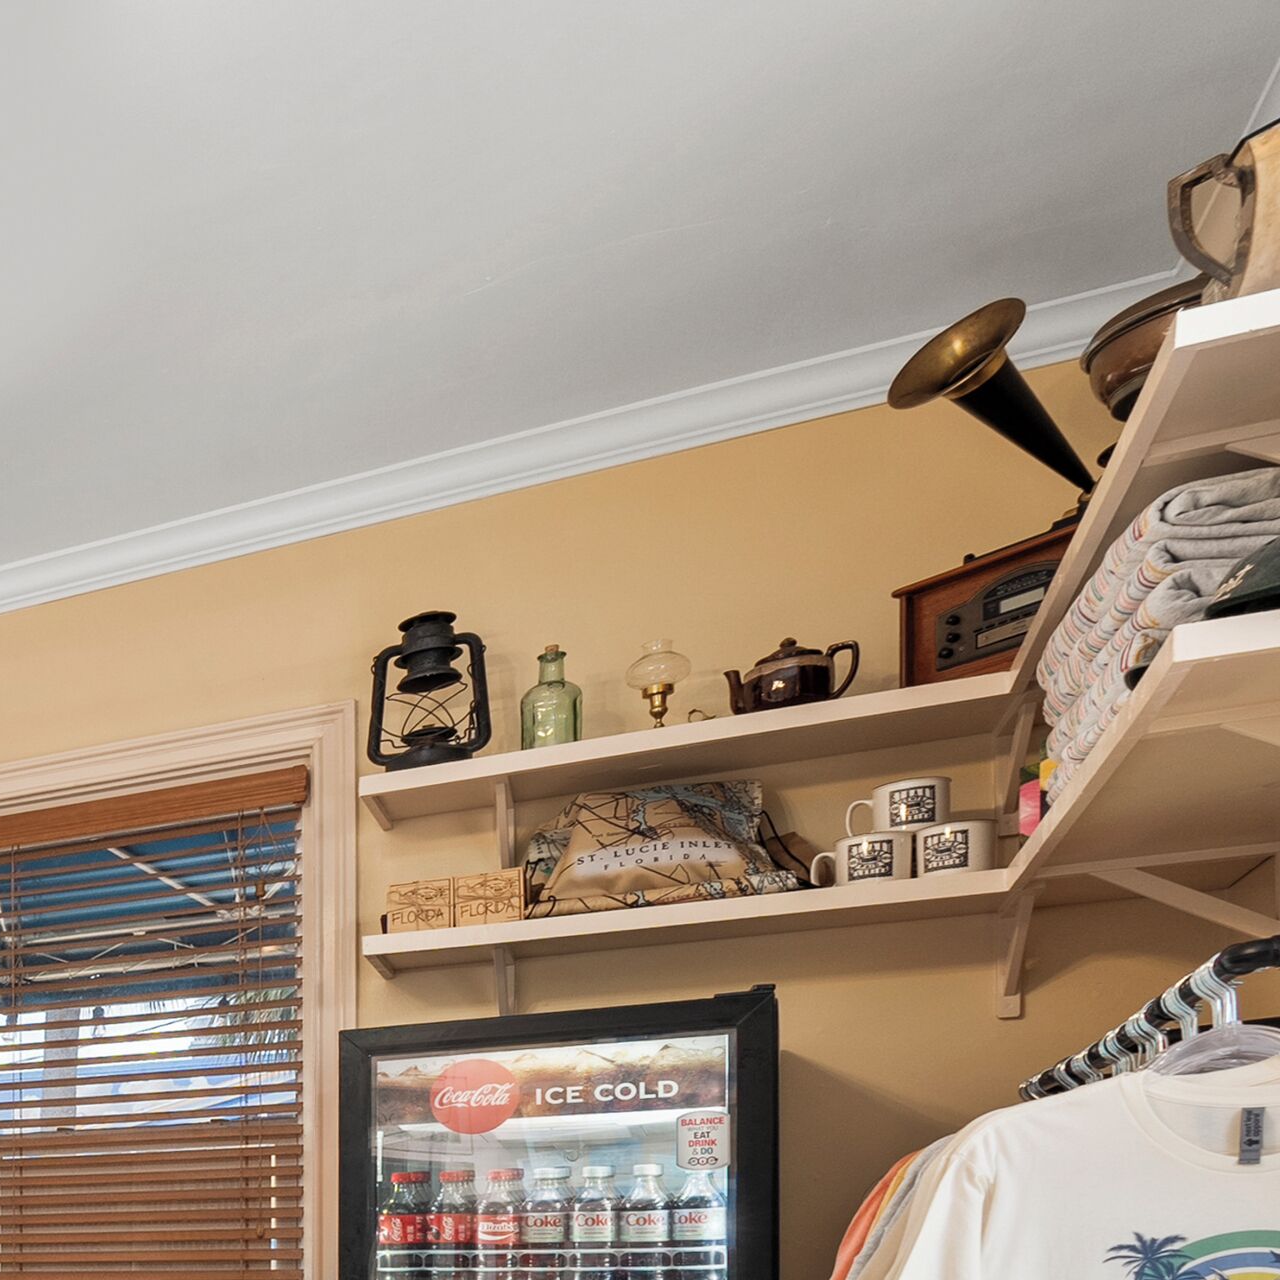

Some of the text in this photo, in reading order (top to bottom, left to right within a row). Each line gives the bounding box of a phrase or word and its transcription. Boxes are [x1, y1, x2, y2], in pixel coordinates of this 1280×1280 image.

[576, 854, 604, 866] ST.
[614, 841, 671, 859] LUCIE
[603, 853, 708, 871] FLORIDA
[391, 908, 445, 925] FLORIDA
[458, 900, 516, 919] FLORIDA
[434, 1080, 680, 1109] Coca-Cola ICE COLD
[680, 1116, 725, 1127] BALANCE
[693, 1131, 711, 1140] EAT
[688, 1139, 718, 1148] DRINK
[700, 1147, 714, 1155] DO
[525, 1215, 562, 1228] Coke
[575, 1213, 611, 1228] Coke
[626, 1212, 665, 1228] Coke
